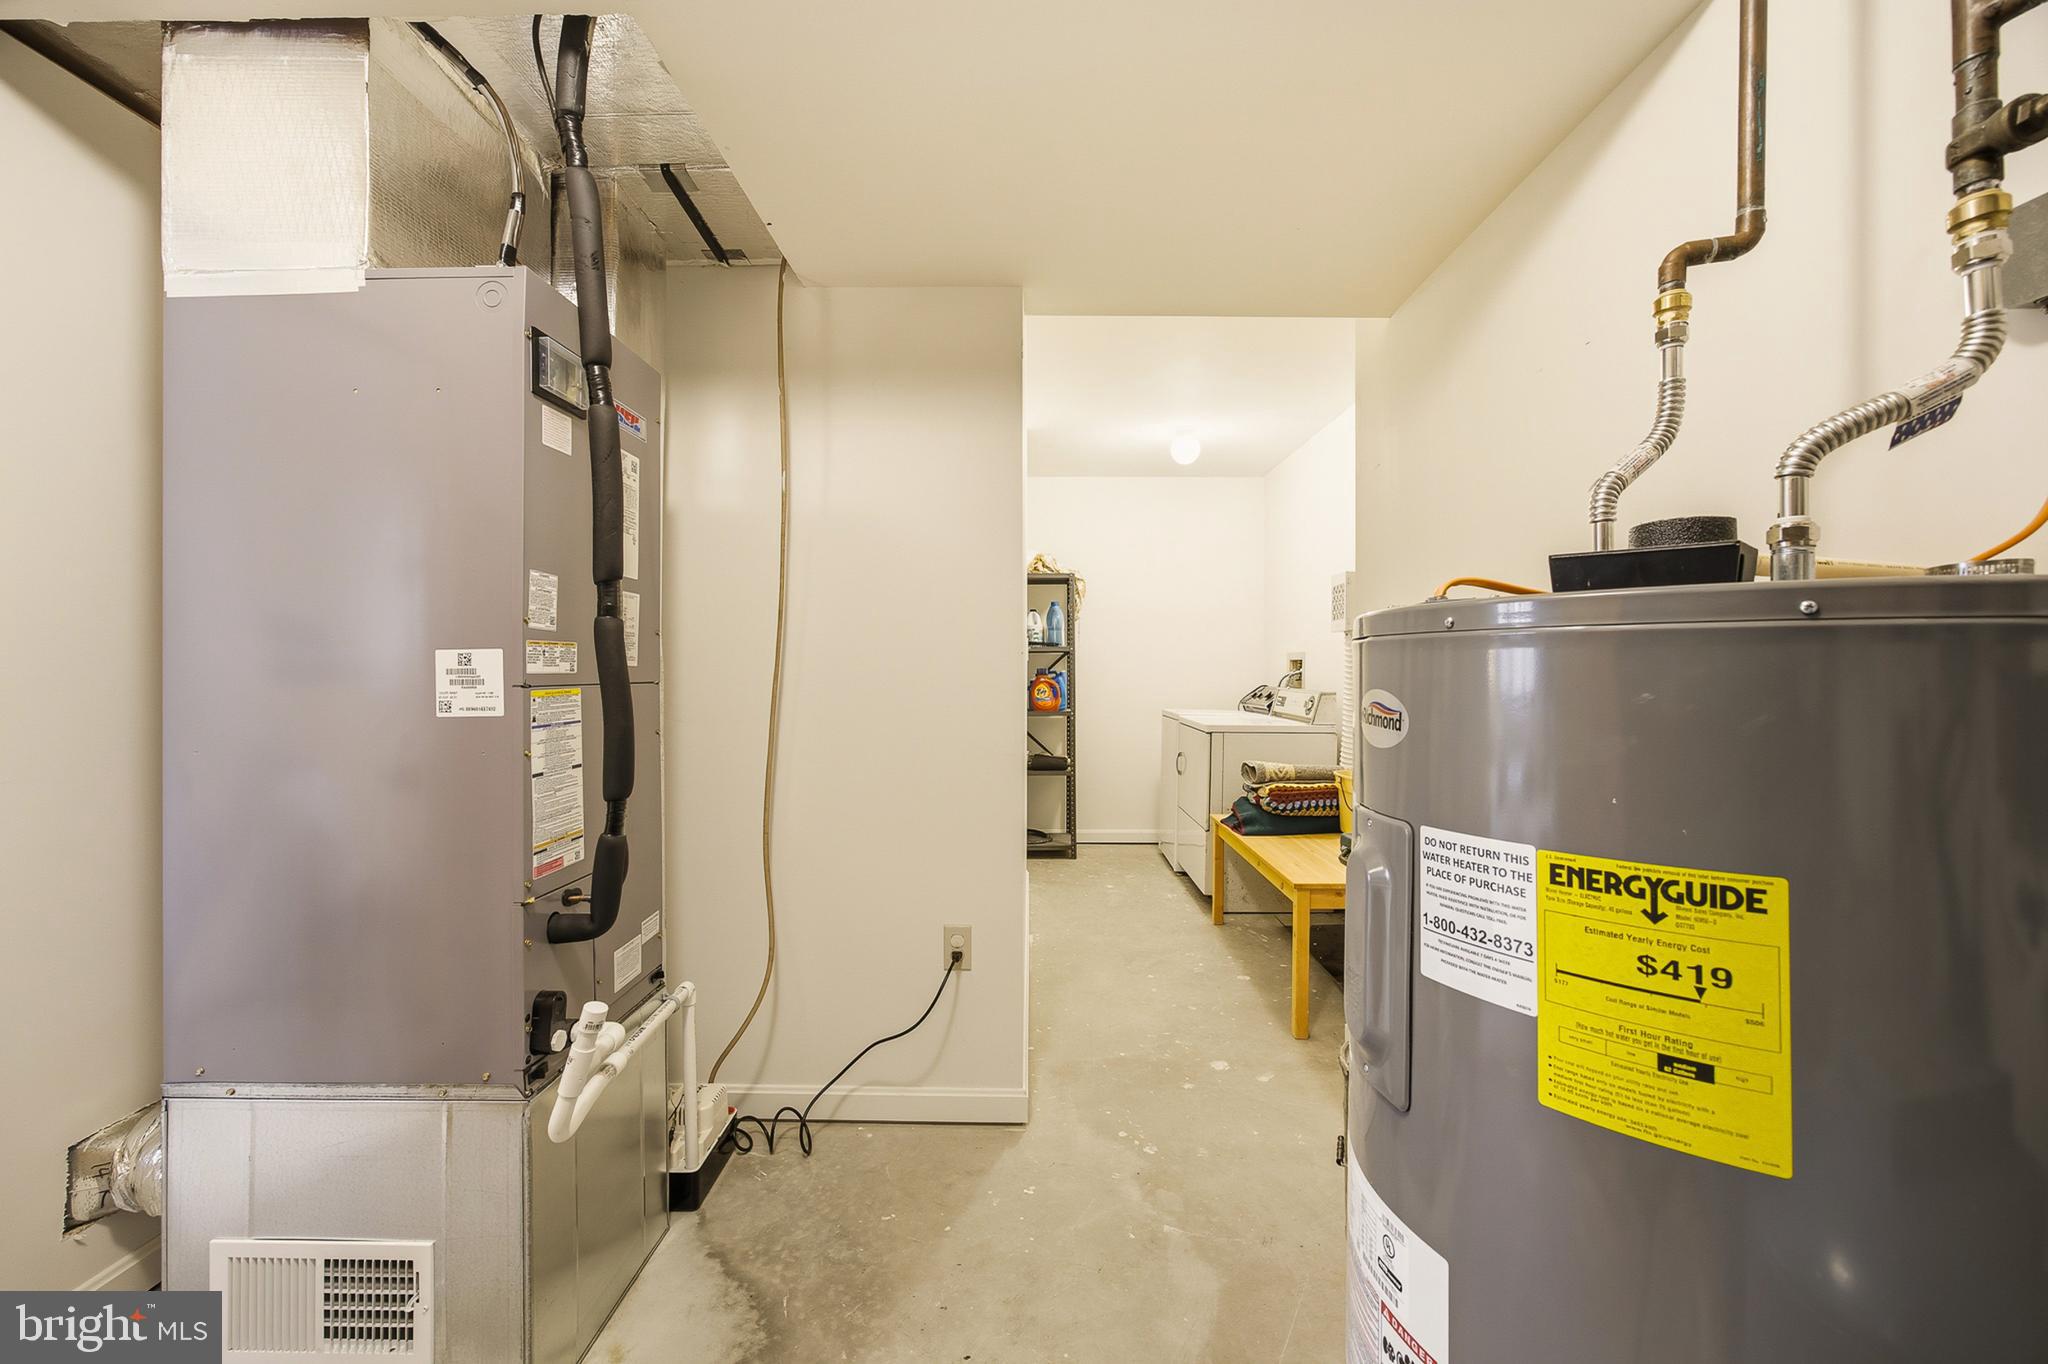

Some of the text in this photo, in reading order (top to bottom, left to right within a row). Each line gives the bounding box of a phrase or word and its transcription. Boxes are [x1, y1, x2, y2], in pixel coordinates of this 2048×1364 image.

[1423, 851, 1533, 883] WATER HEATER TO THE
[1424, 837, 1529, 866] DO NOT RETURN THIS
[1427, 866, 1526, 898] PLACE OF PURCHASE
[1549, 862, 1768, 920] ENERGYGUIDE
[1423, 912, 1533, 957] 1-800-432-8373
[1584, 926, 1710, 954] Estimated Yearly Energy Cost
[1636, 954, 1733, 989] $419
[1618, 1025, 1694, 1050] First Hour Rating
